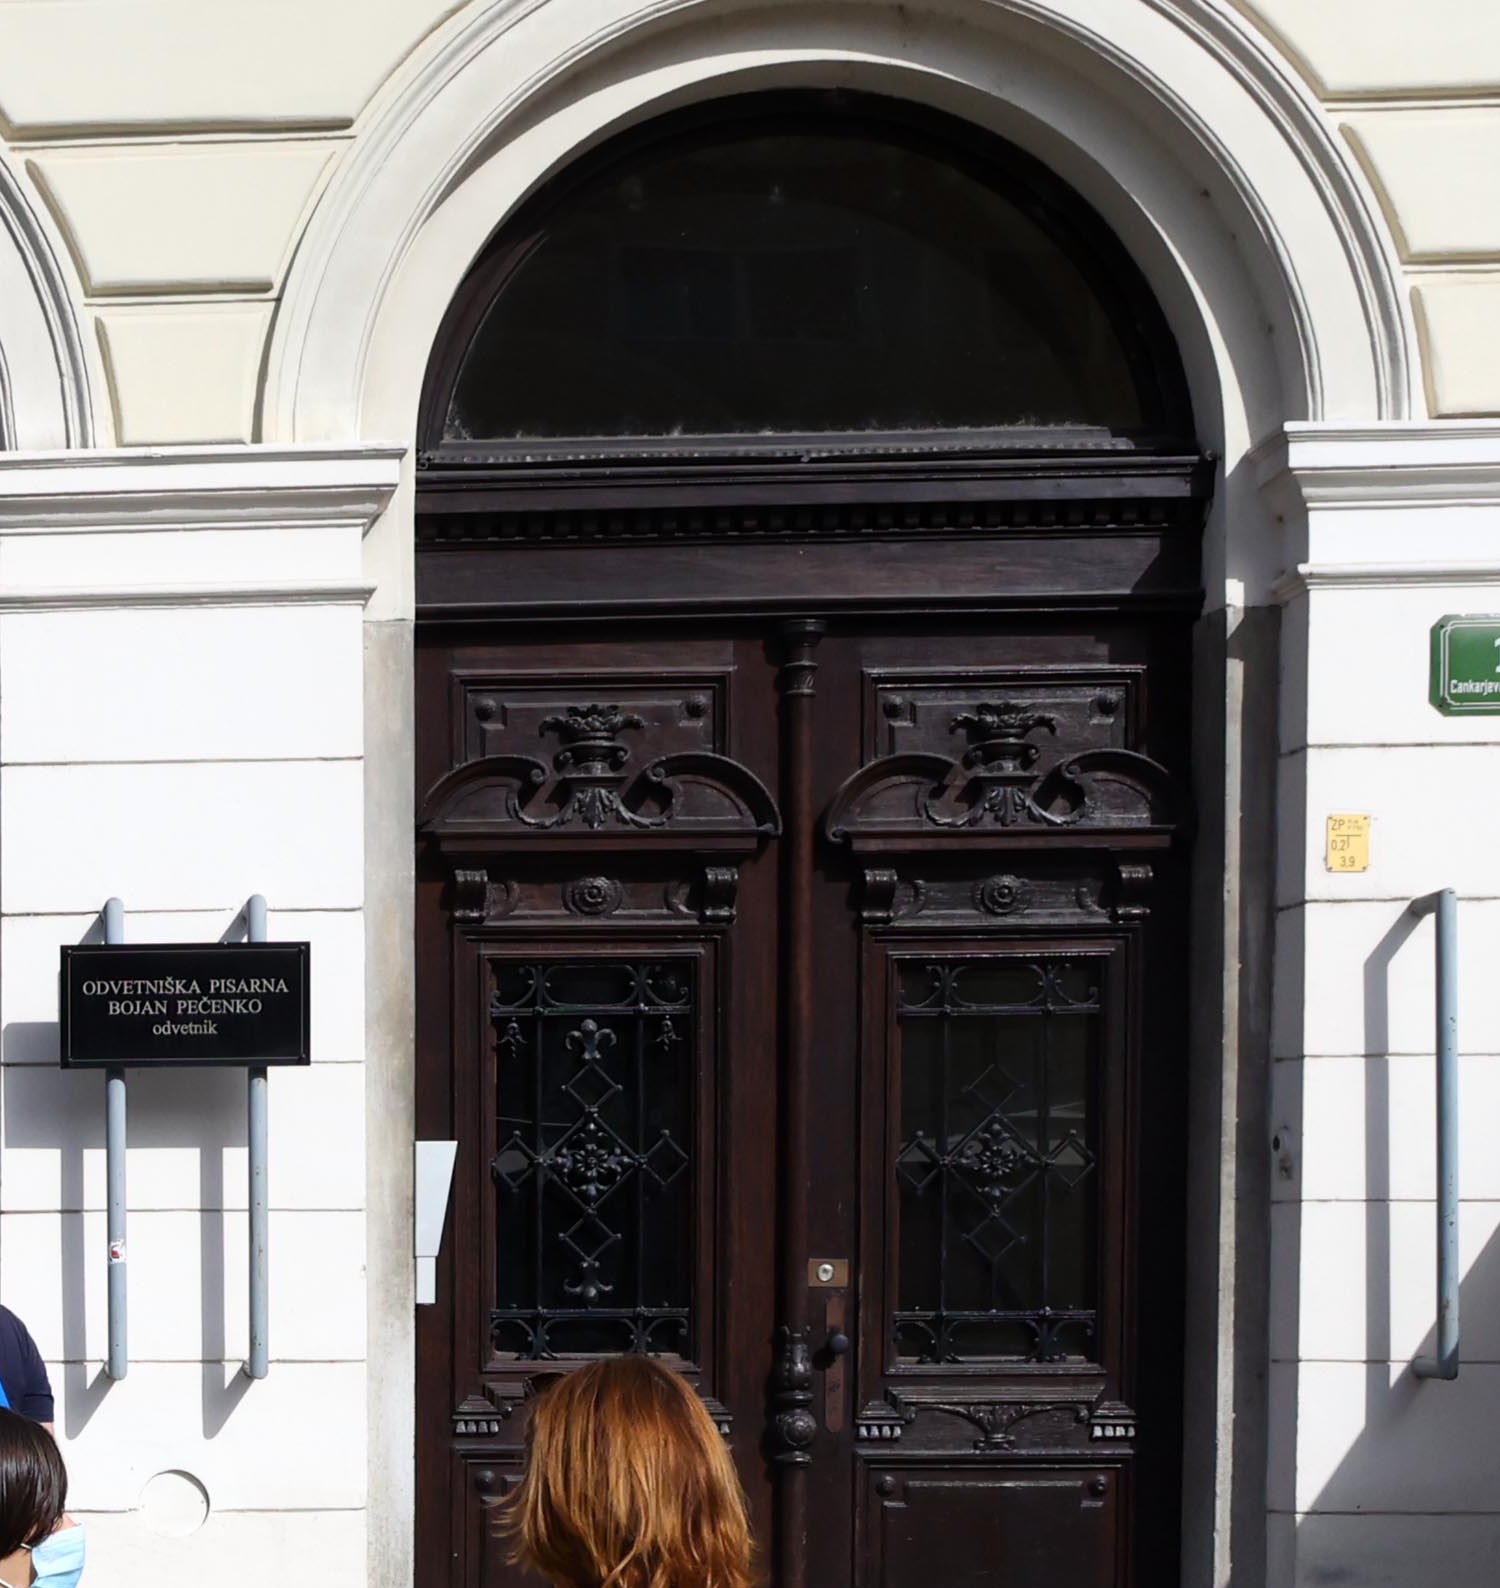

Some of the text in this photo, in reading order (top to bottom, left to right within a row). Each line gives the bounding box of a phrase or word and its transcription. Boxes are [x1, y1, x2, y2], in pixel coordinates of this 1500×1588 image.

[1450, 679, 1500, 696] Cankarjev
[82, 976, 289, 996] ODVETNIŠKA PISARNA
[108, 996, 263, 1016] BOJAN PEČENKO
[152, 1019, 218, 1035] odvetnik
